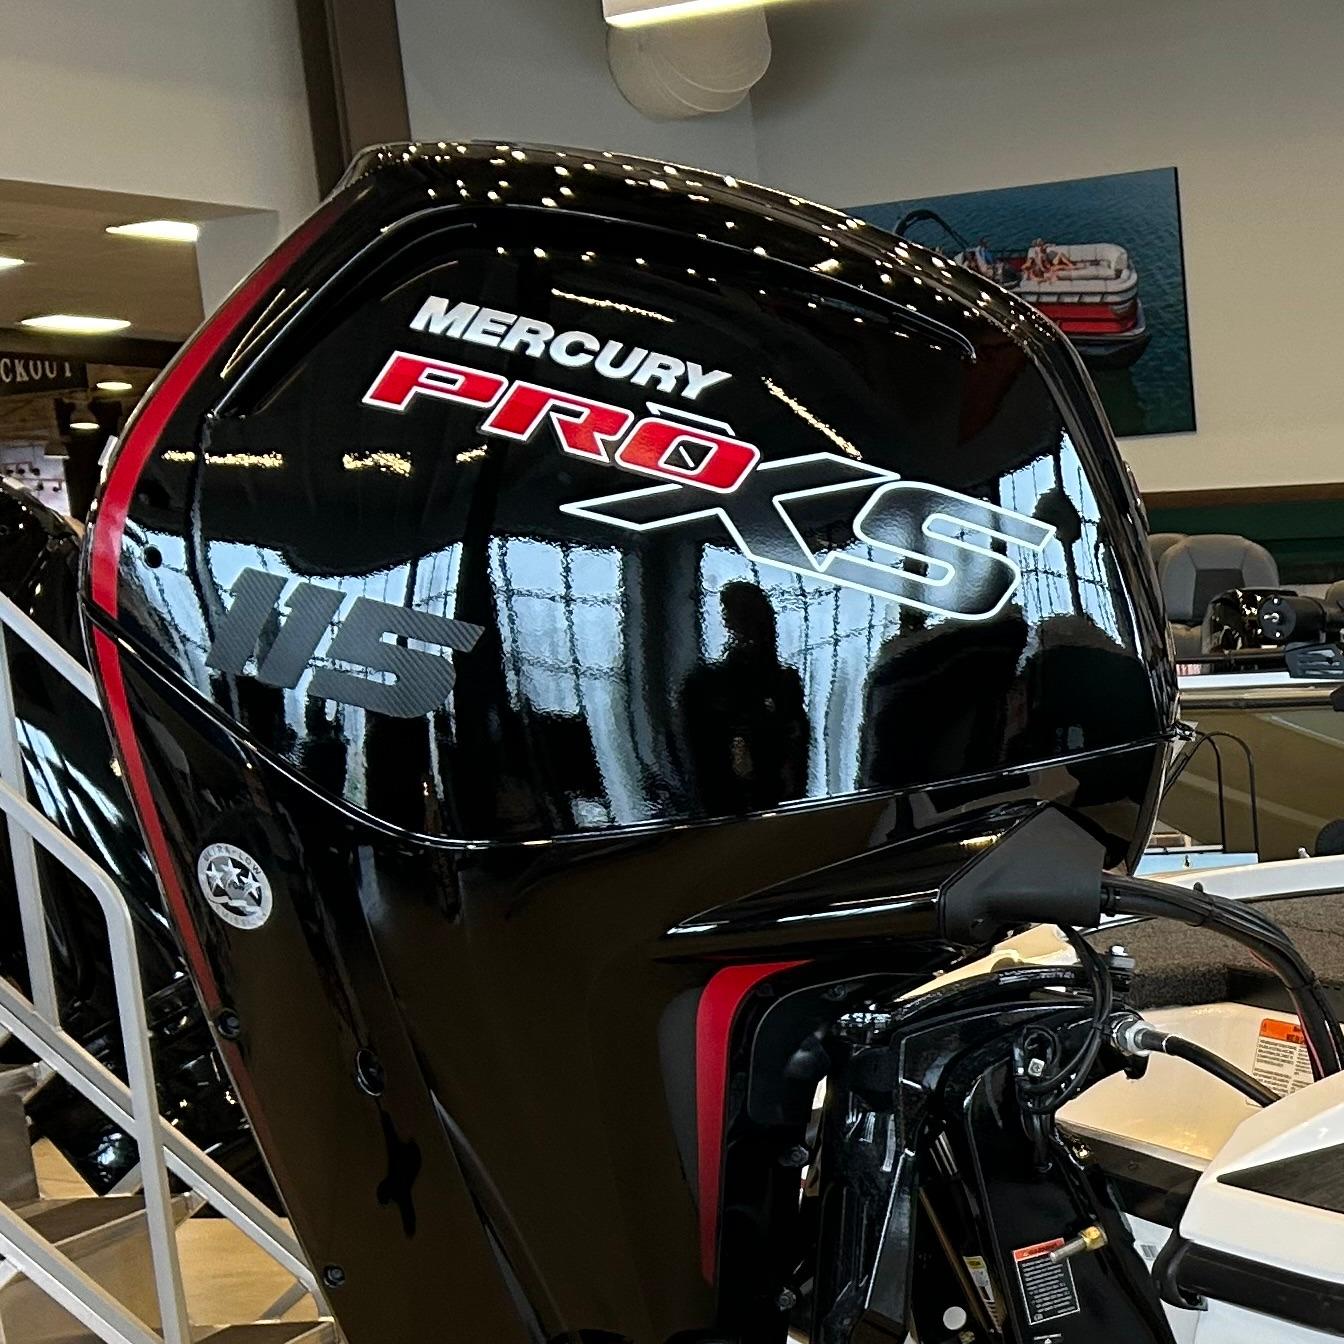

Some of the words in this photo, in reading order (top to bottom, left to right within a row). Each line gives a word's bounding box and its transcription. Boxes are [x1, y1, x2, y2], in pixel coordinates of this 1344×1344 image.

[362, 350, 760, 494] PRO
[410, 296, 732, 400] MERCURY
[560, 452, 1056, 621] XS
[205, 567, 486, 719] 115
